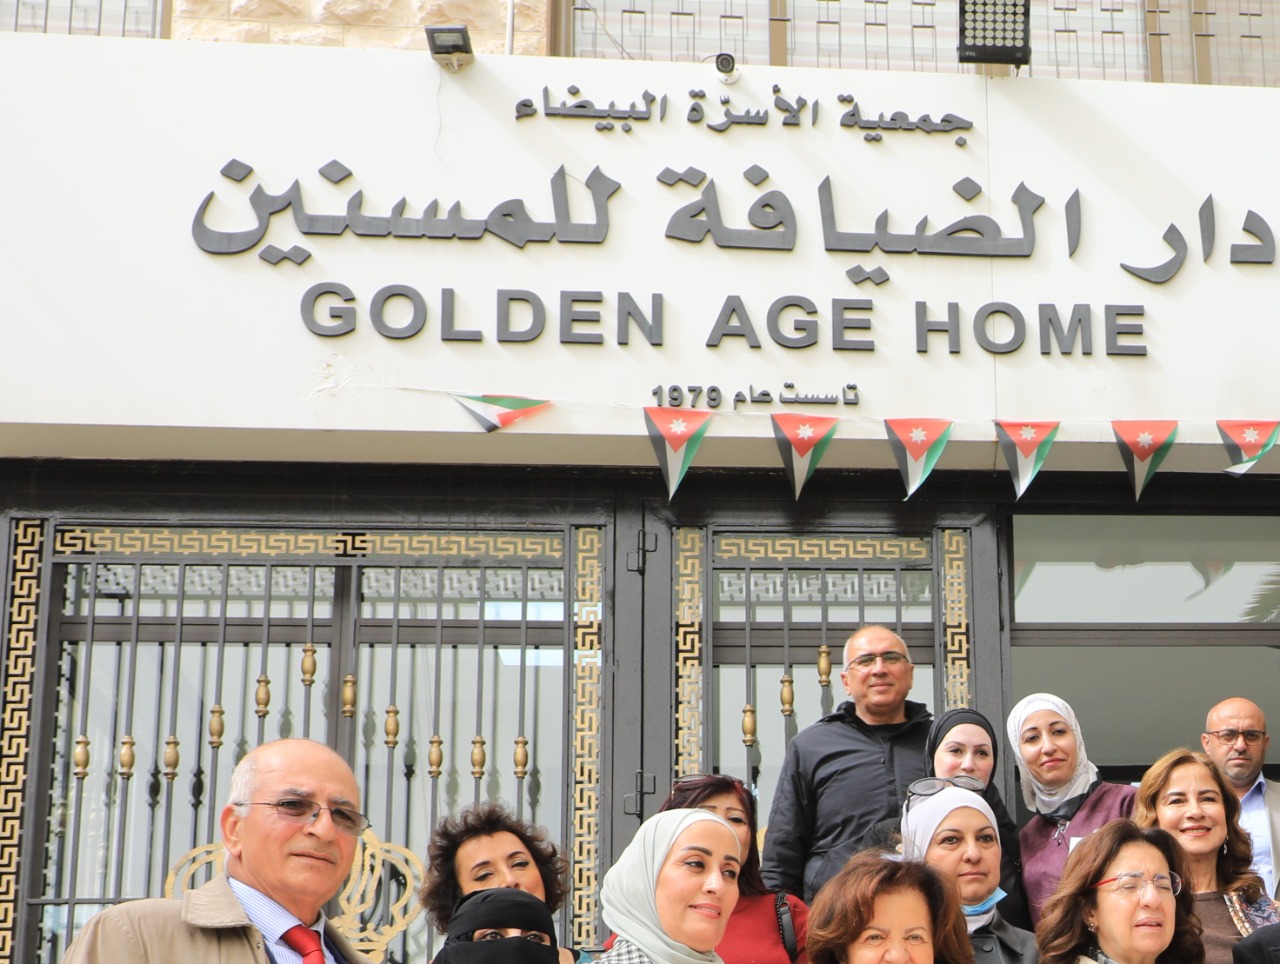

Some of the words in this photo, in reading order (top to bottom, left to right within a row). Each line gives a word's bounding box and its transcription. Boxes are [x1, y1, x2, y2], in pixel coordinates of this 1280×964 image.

[515, 84, 668, 133] البيضاء
[836, 93, 974, 148] جمعية
[192, 158, 622, 267] للمسنين
[656, 164, 1082, 287] الضيافة
[1119, 194, 1277, 287] دار
[300, 282, 664, 348] GOLDEN
[705, 295, 876, 355] AGE
[915, 301, 1148, 358] HOME
[651, 384, 723, 410] 1979
[733, 384, 775, 411] عام
